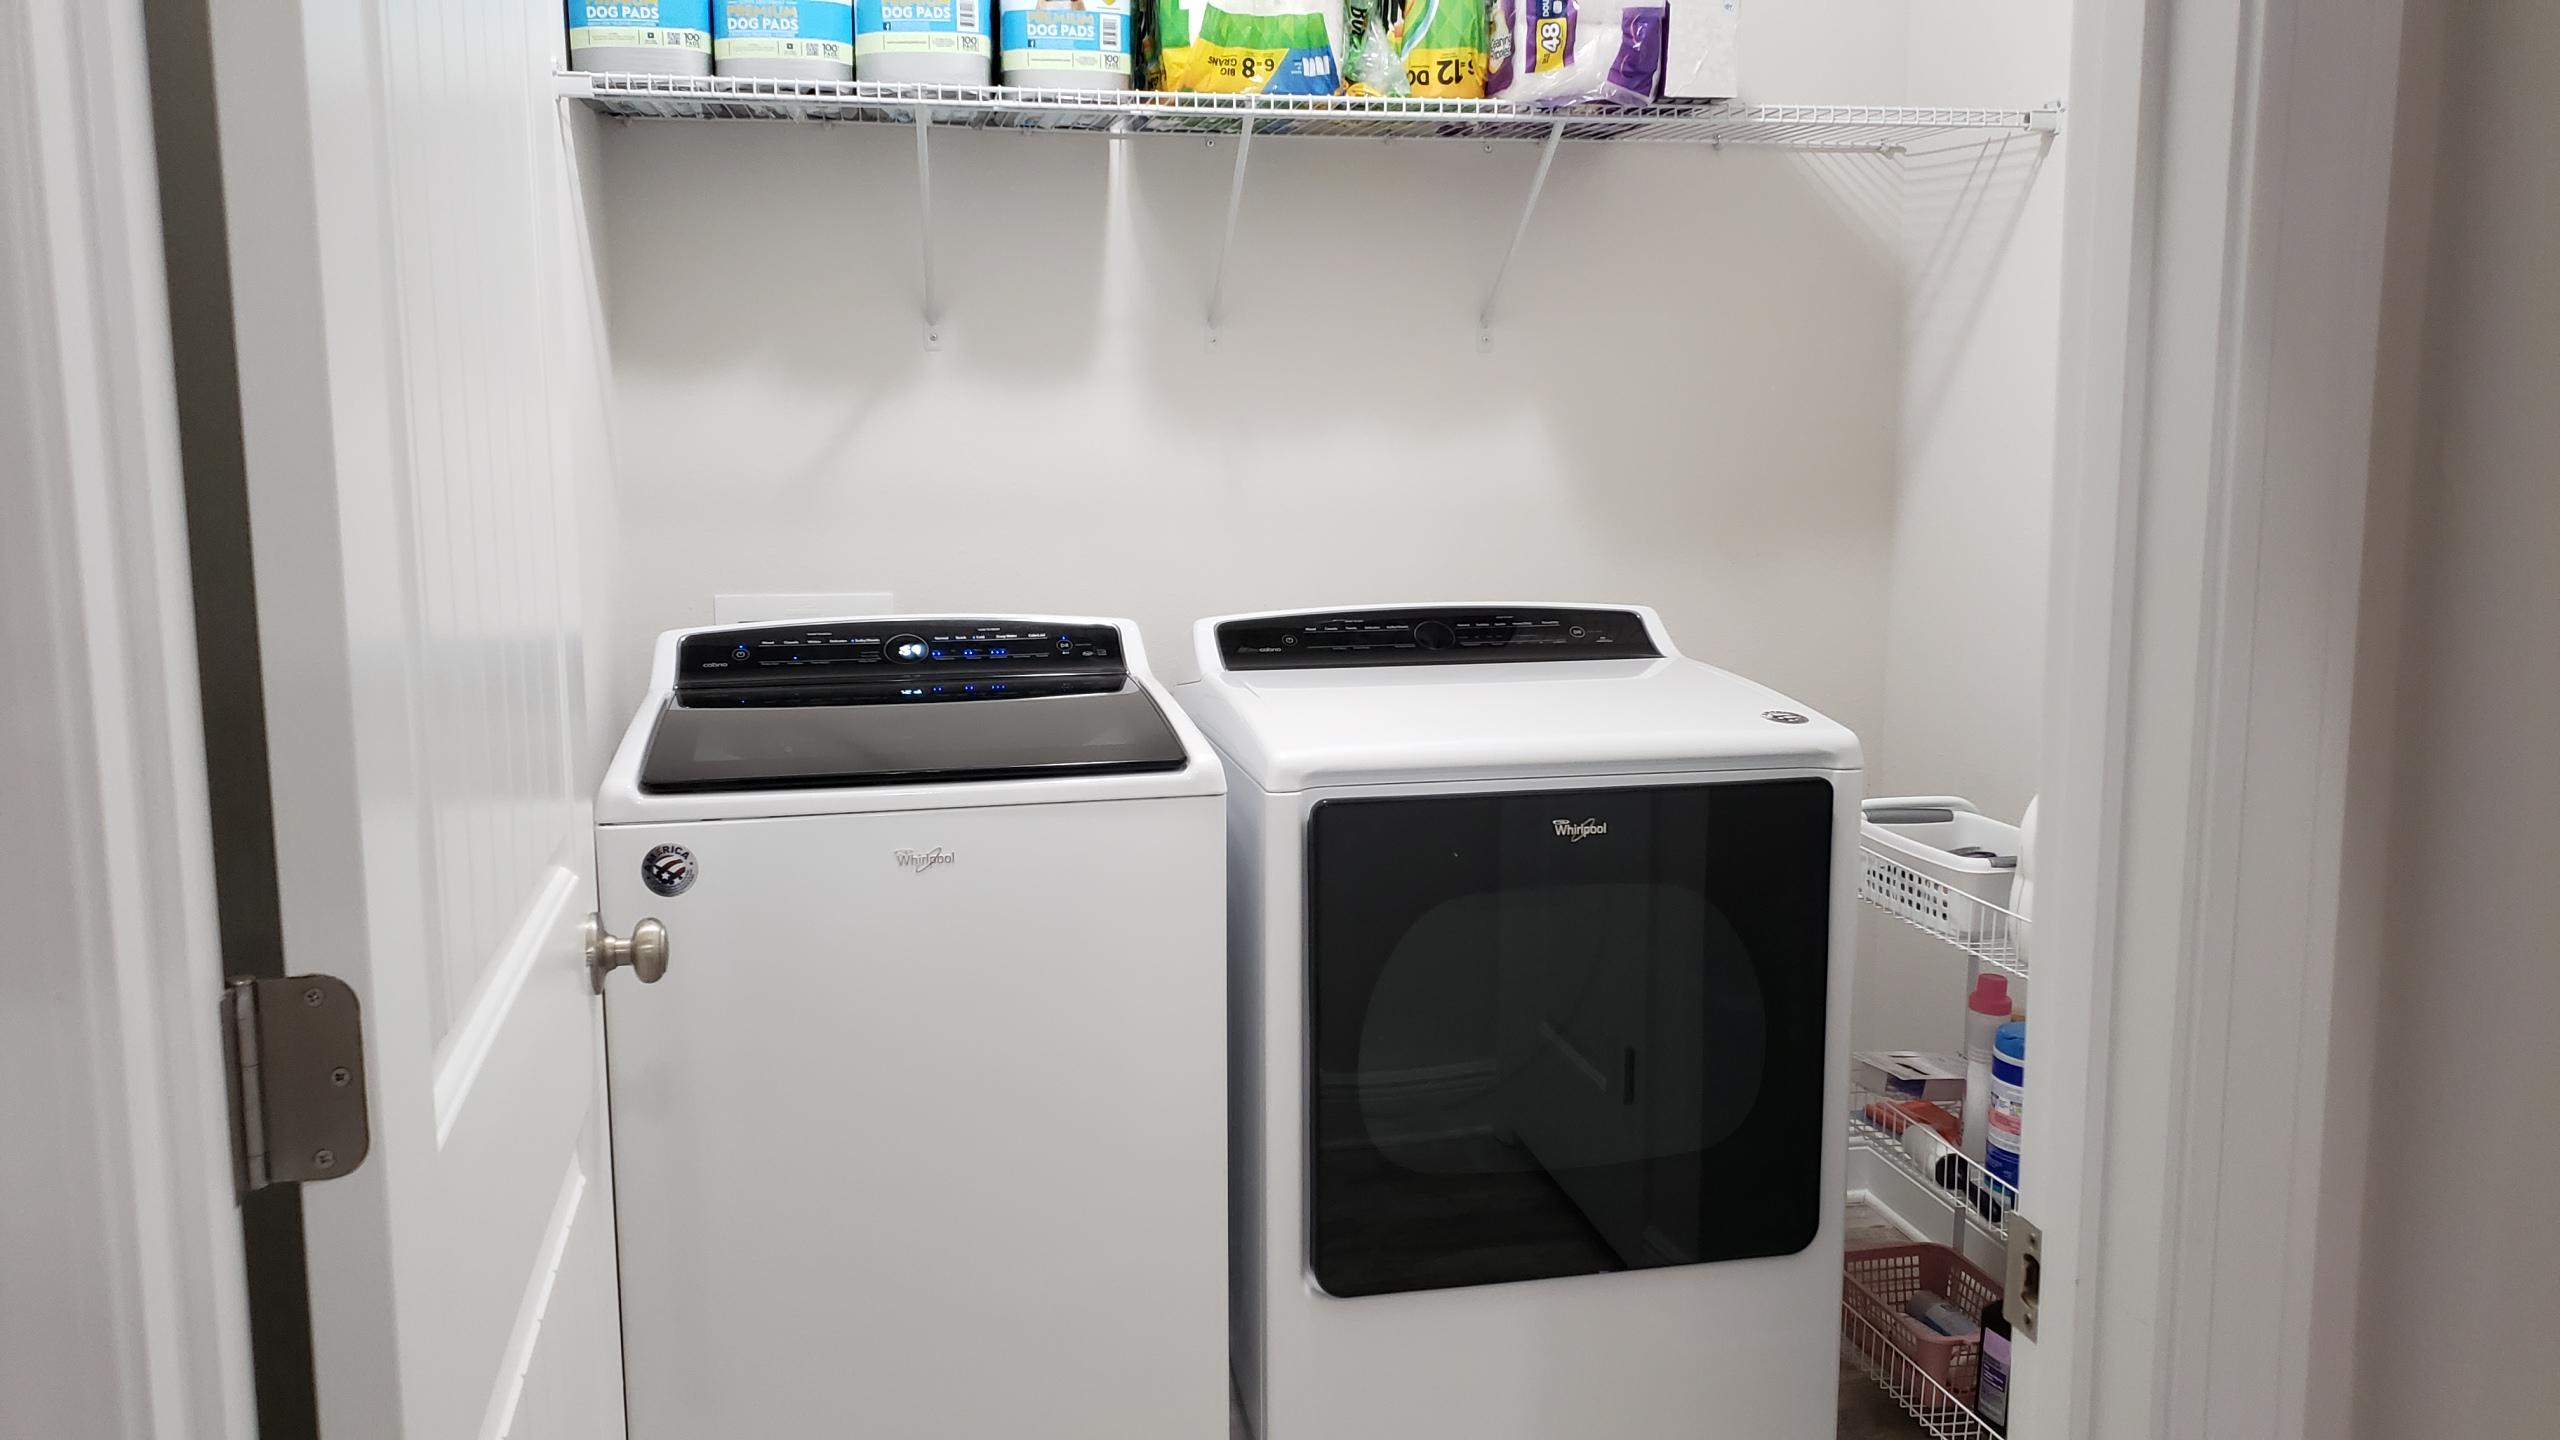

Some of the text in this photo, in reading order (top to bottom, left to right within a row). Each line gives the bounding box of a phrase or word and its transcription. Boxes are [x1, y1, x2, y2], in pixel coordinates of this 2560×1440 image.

[586, 6, 660, 19] DOG PADS
[882, 6, 951, 19] DOG PADS
[727, 18, 799, 31] DOG PADS
[1026, 24, 1095, 37] DOG PADS
[684, 33, 700, 42] 100
[1541, 22, 1562, 53] 48
[1220, 67, 1235, 76] BIG
[1554, 821, 1608, 839] Whirlpool
[896, 850, 955, 868] Whirlpool
